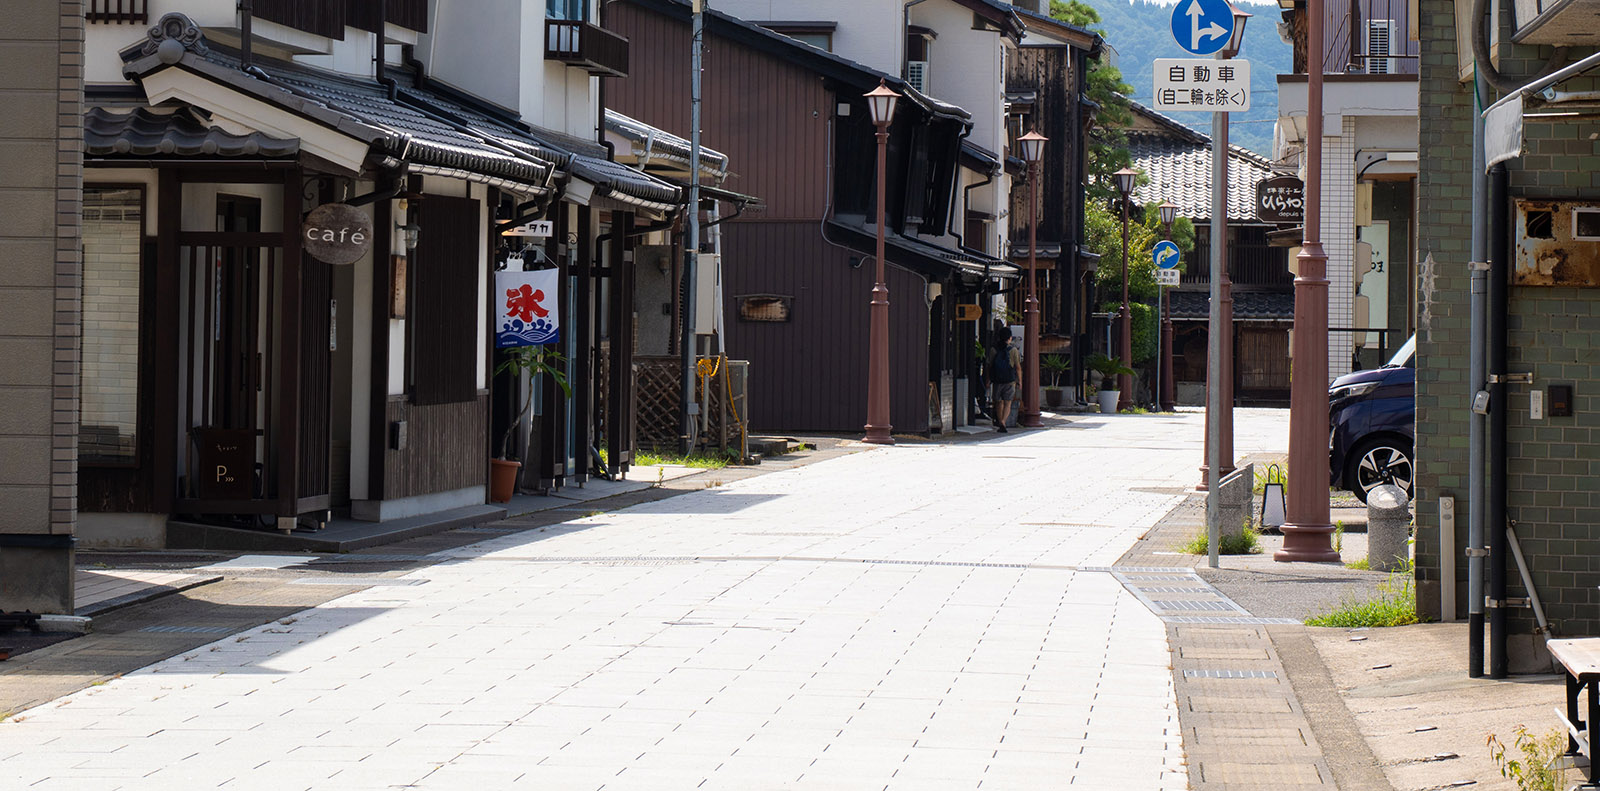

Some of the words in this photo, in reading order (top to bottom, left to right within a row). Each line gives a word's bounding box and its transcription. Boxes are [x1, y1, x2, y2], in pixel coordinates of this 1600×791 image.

[1169, 65, 1235, 83] 自動車
[1157, 88, 1246, 106] (自二輪を除く)
[1262, 194, 1304, 211] ひらや
[306, 227, 365, 245] café
[506, 283, 550, 323] 氷
[216, 465, 227, 482] P
